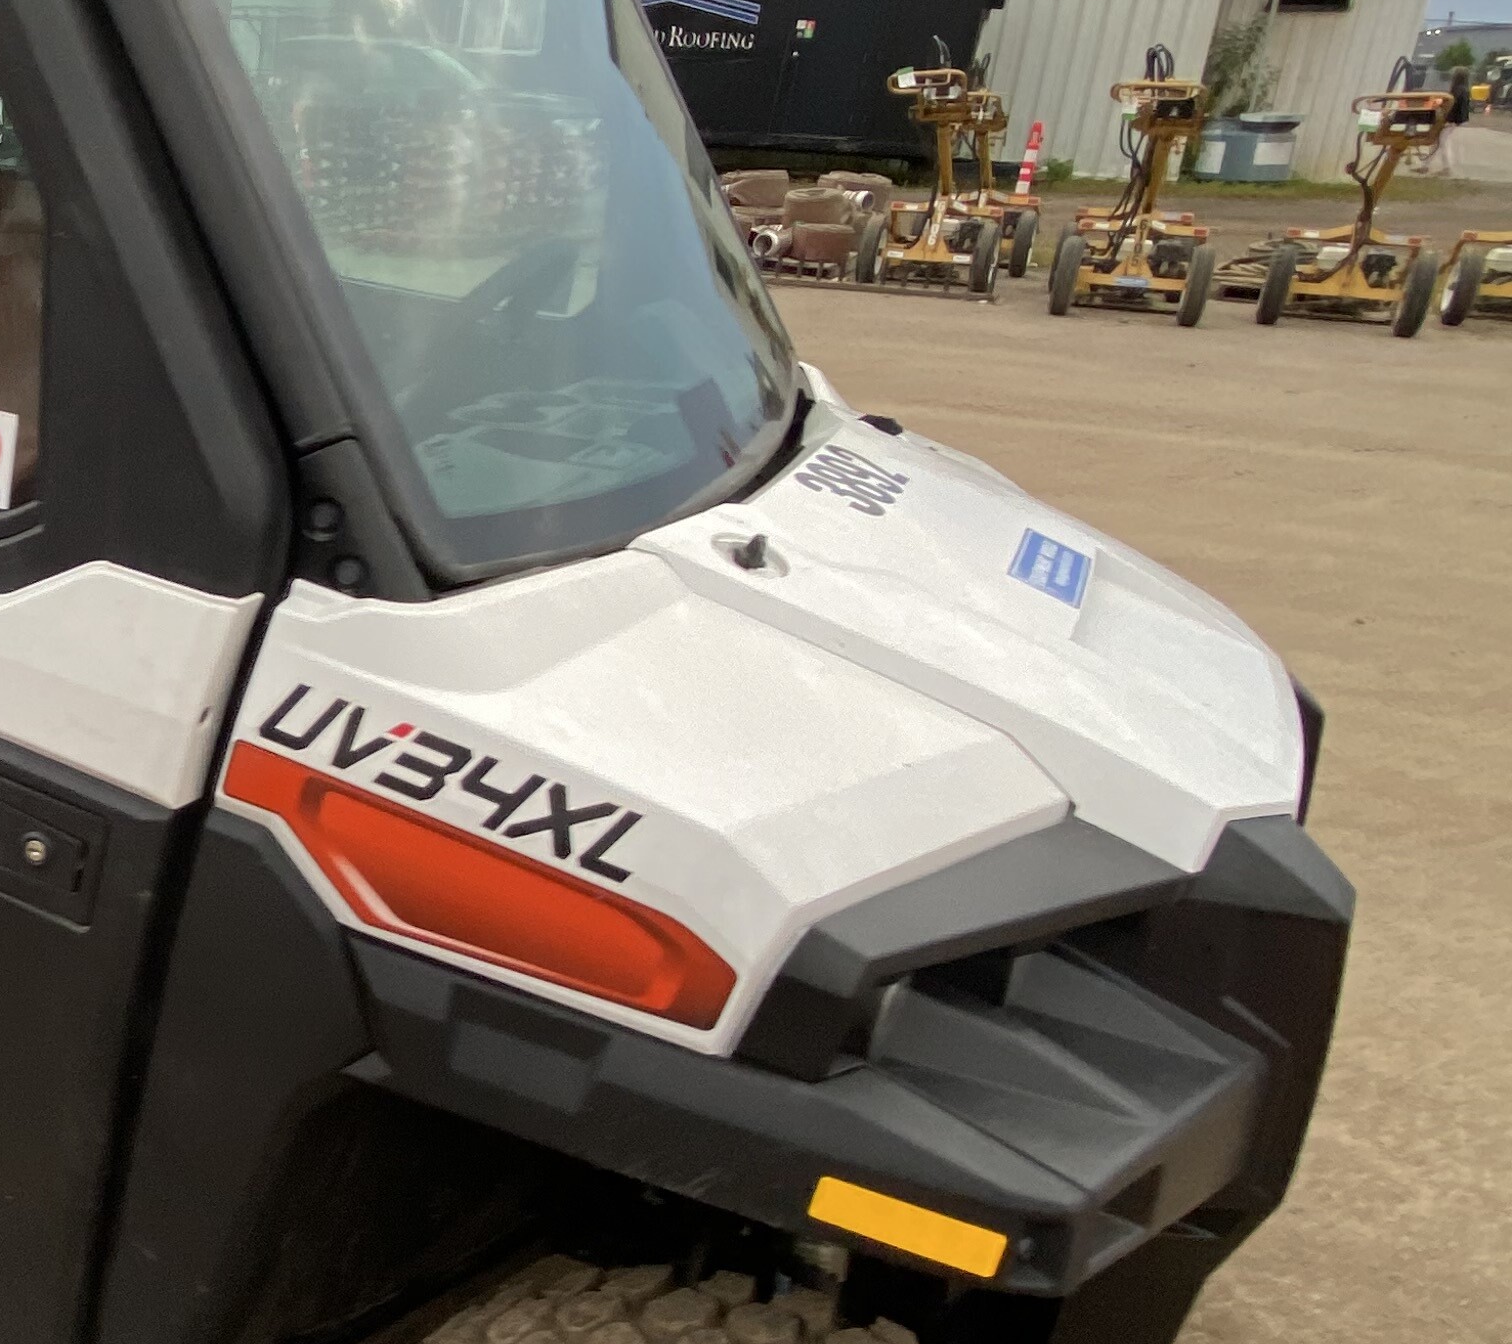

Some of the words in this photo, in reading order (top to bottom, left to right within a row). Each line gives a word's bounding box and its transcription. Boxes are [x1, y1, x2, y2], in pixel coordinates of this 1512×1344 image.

[669, 25, 755, 50] ROOFING
[794, 444, 911, 517] 3892
[259, 683, 644, 884] UV34XL
